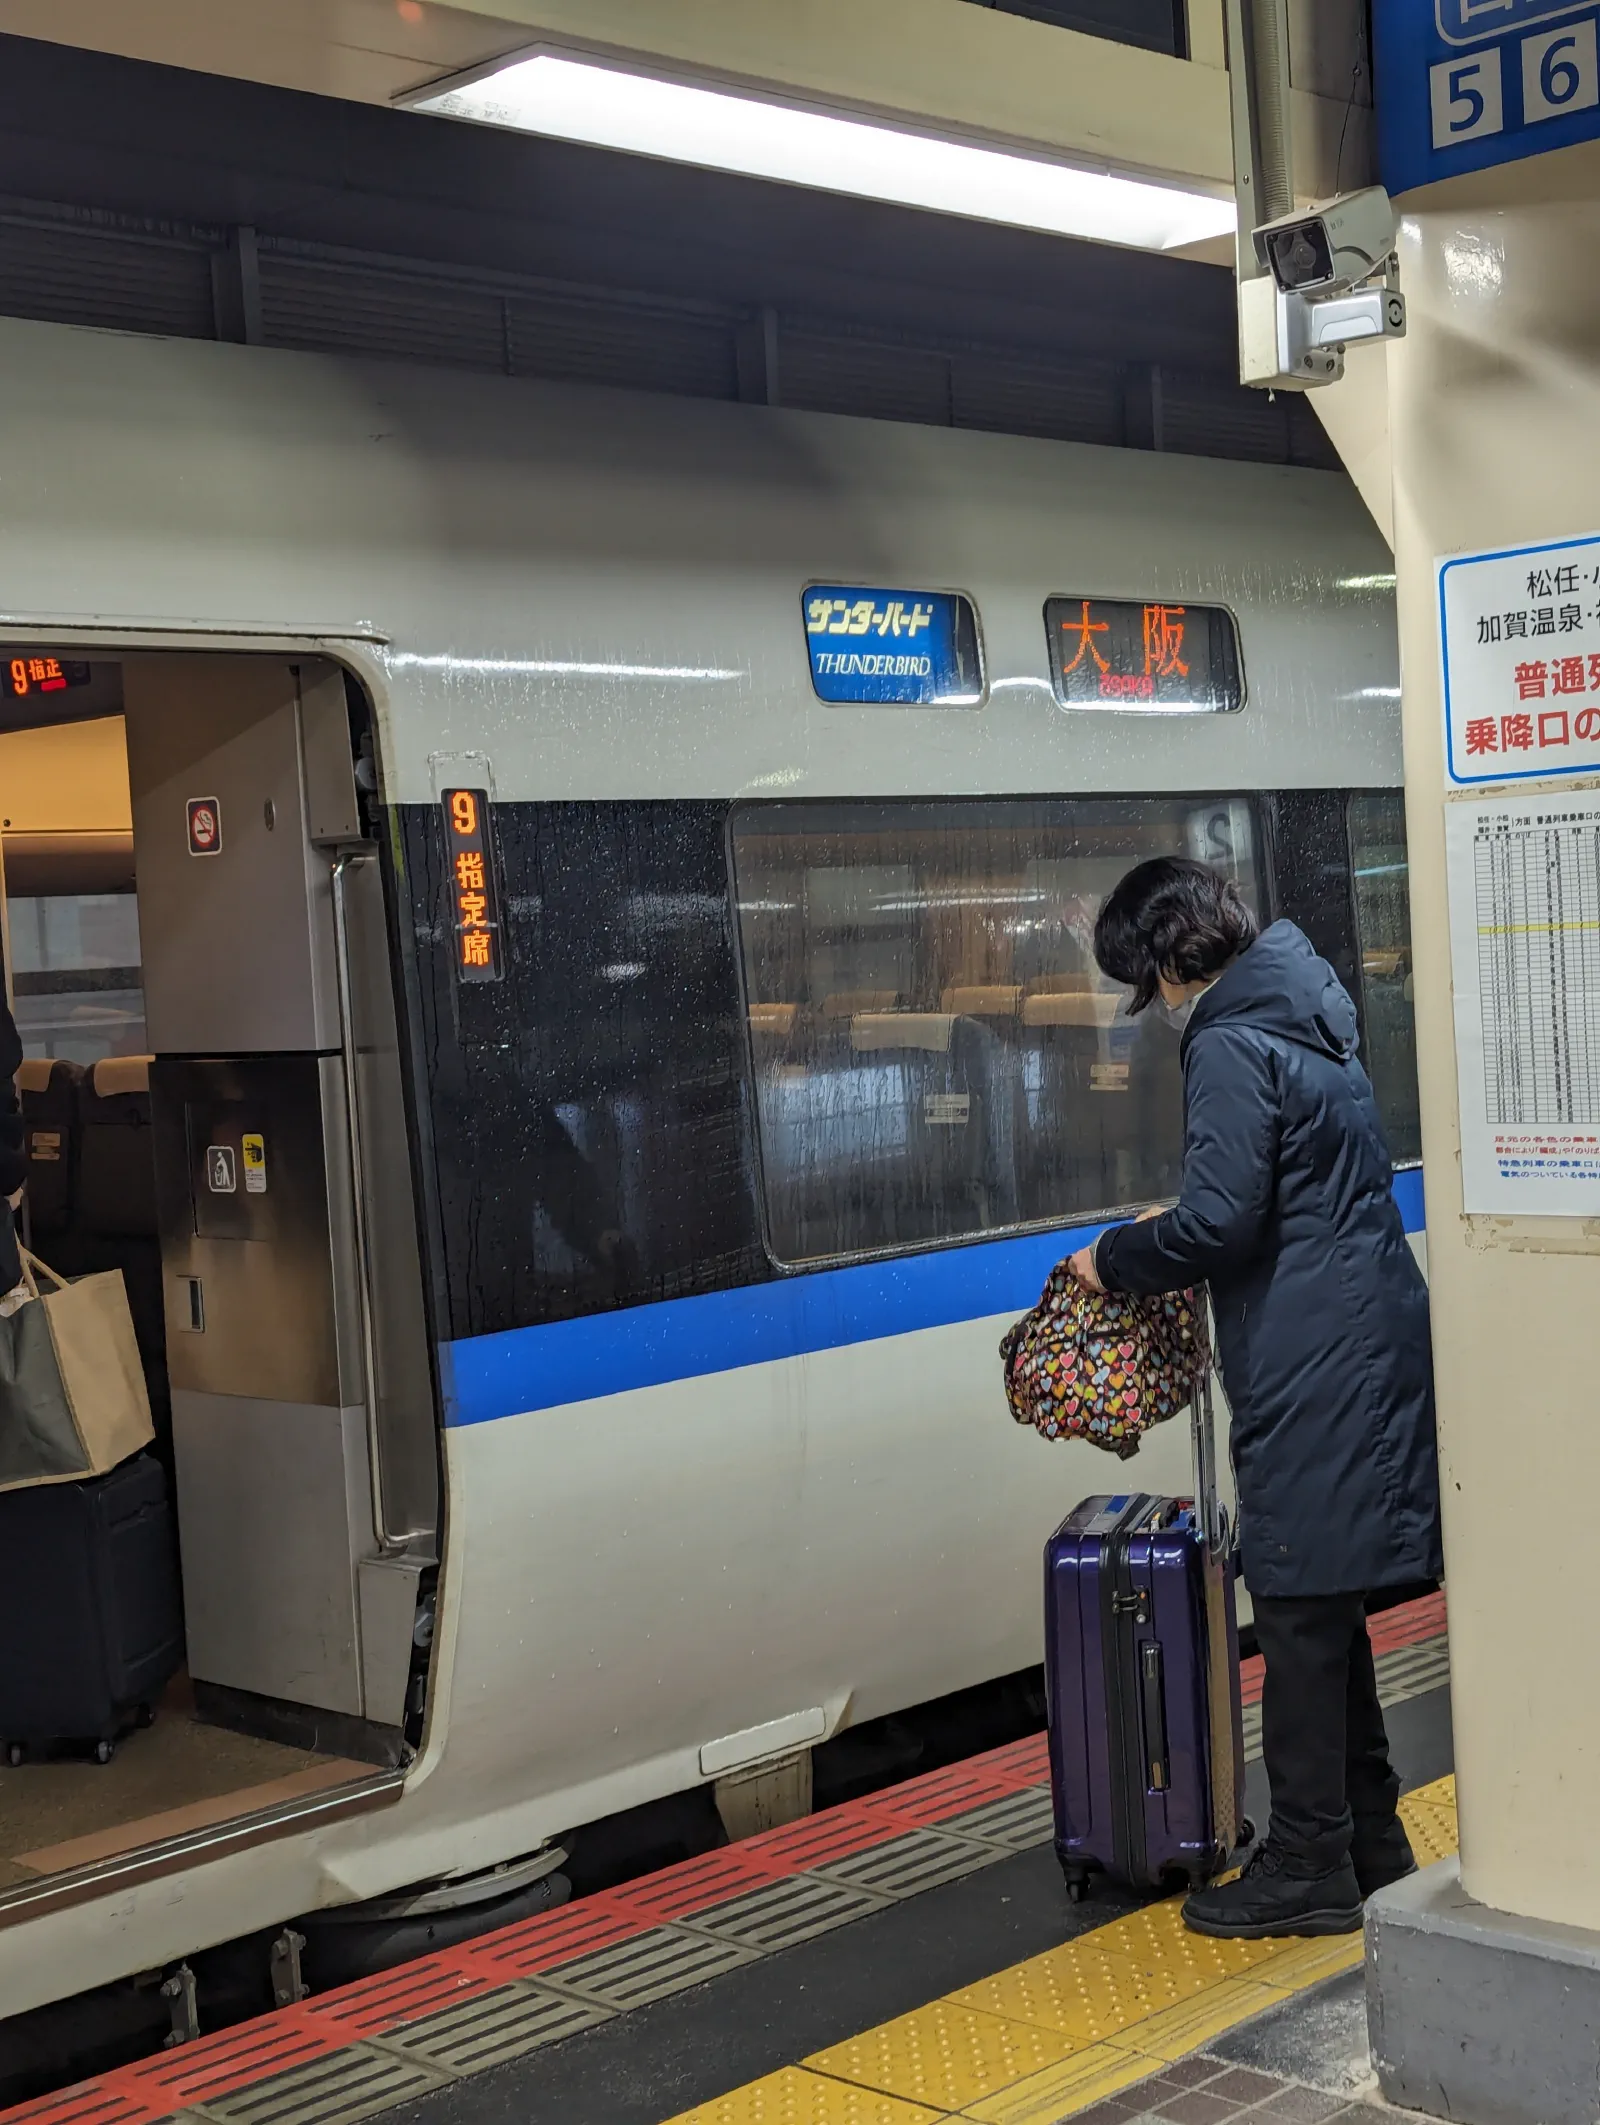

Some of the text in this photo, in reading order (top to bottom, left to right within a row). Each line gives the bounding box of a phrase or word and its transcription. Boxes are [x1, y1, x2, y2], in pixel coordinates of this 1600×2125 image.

[1448, 37, 1580, 132] 5 6
[807, 599, 934, 637] サンダーバード
[1061, 601, 1189, 677] 大阪
[1477, 599, 1600, 644] 加賀温泉・
[11, 659, 29, 695] 9
[816, 653, 931, 677] THUNDERBIRD
[1465, 707, 1600, 756] 乗降口の
[452, 791, 491, 966] 9 指定席
